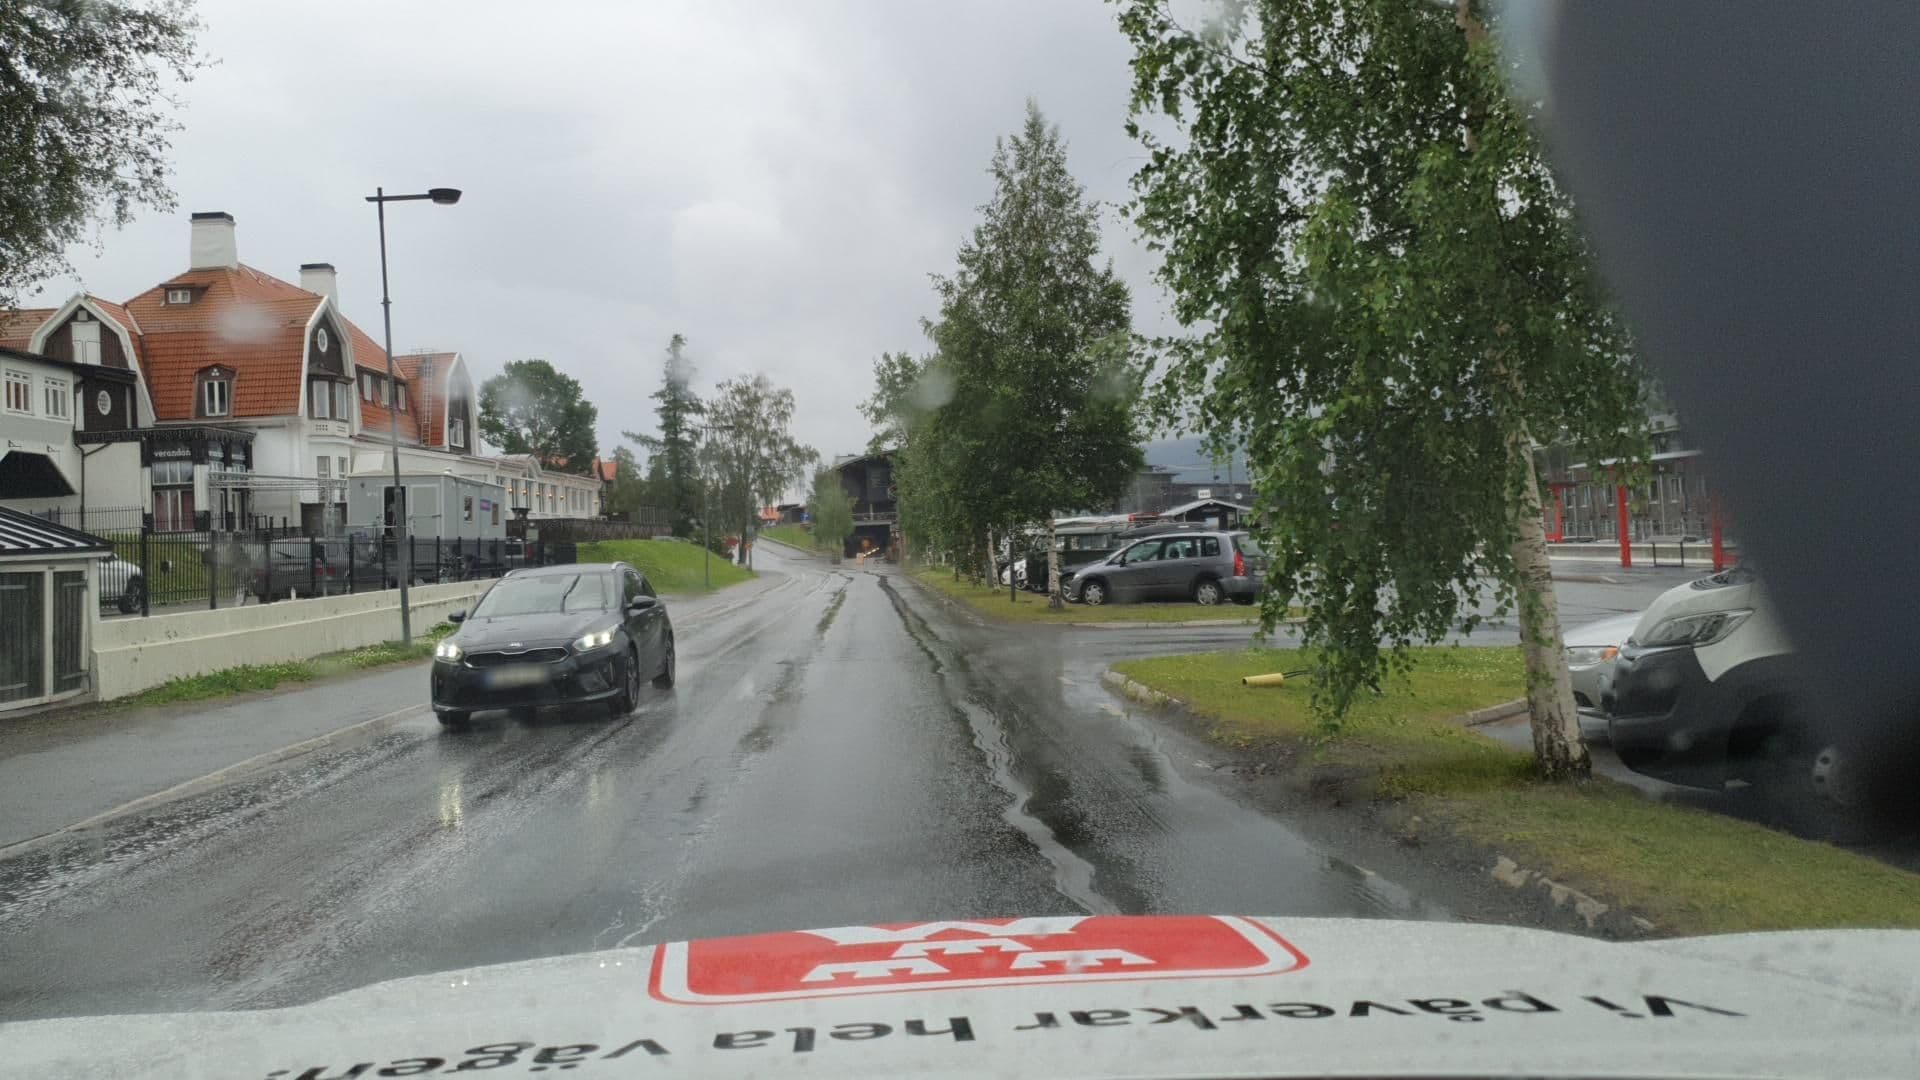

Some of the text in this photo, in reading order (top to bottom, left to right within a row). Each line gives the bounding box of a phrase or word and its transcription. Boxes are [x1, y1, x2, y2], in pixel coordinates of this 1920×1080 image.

[1014, 990, 1561, 1030] påverkar
[1580, 995, 1749, 1017] Vi
[703, 1016, 976, 1053] hela
